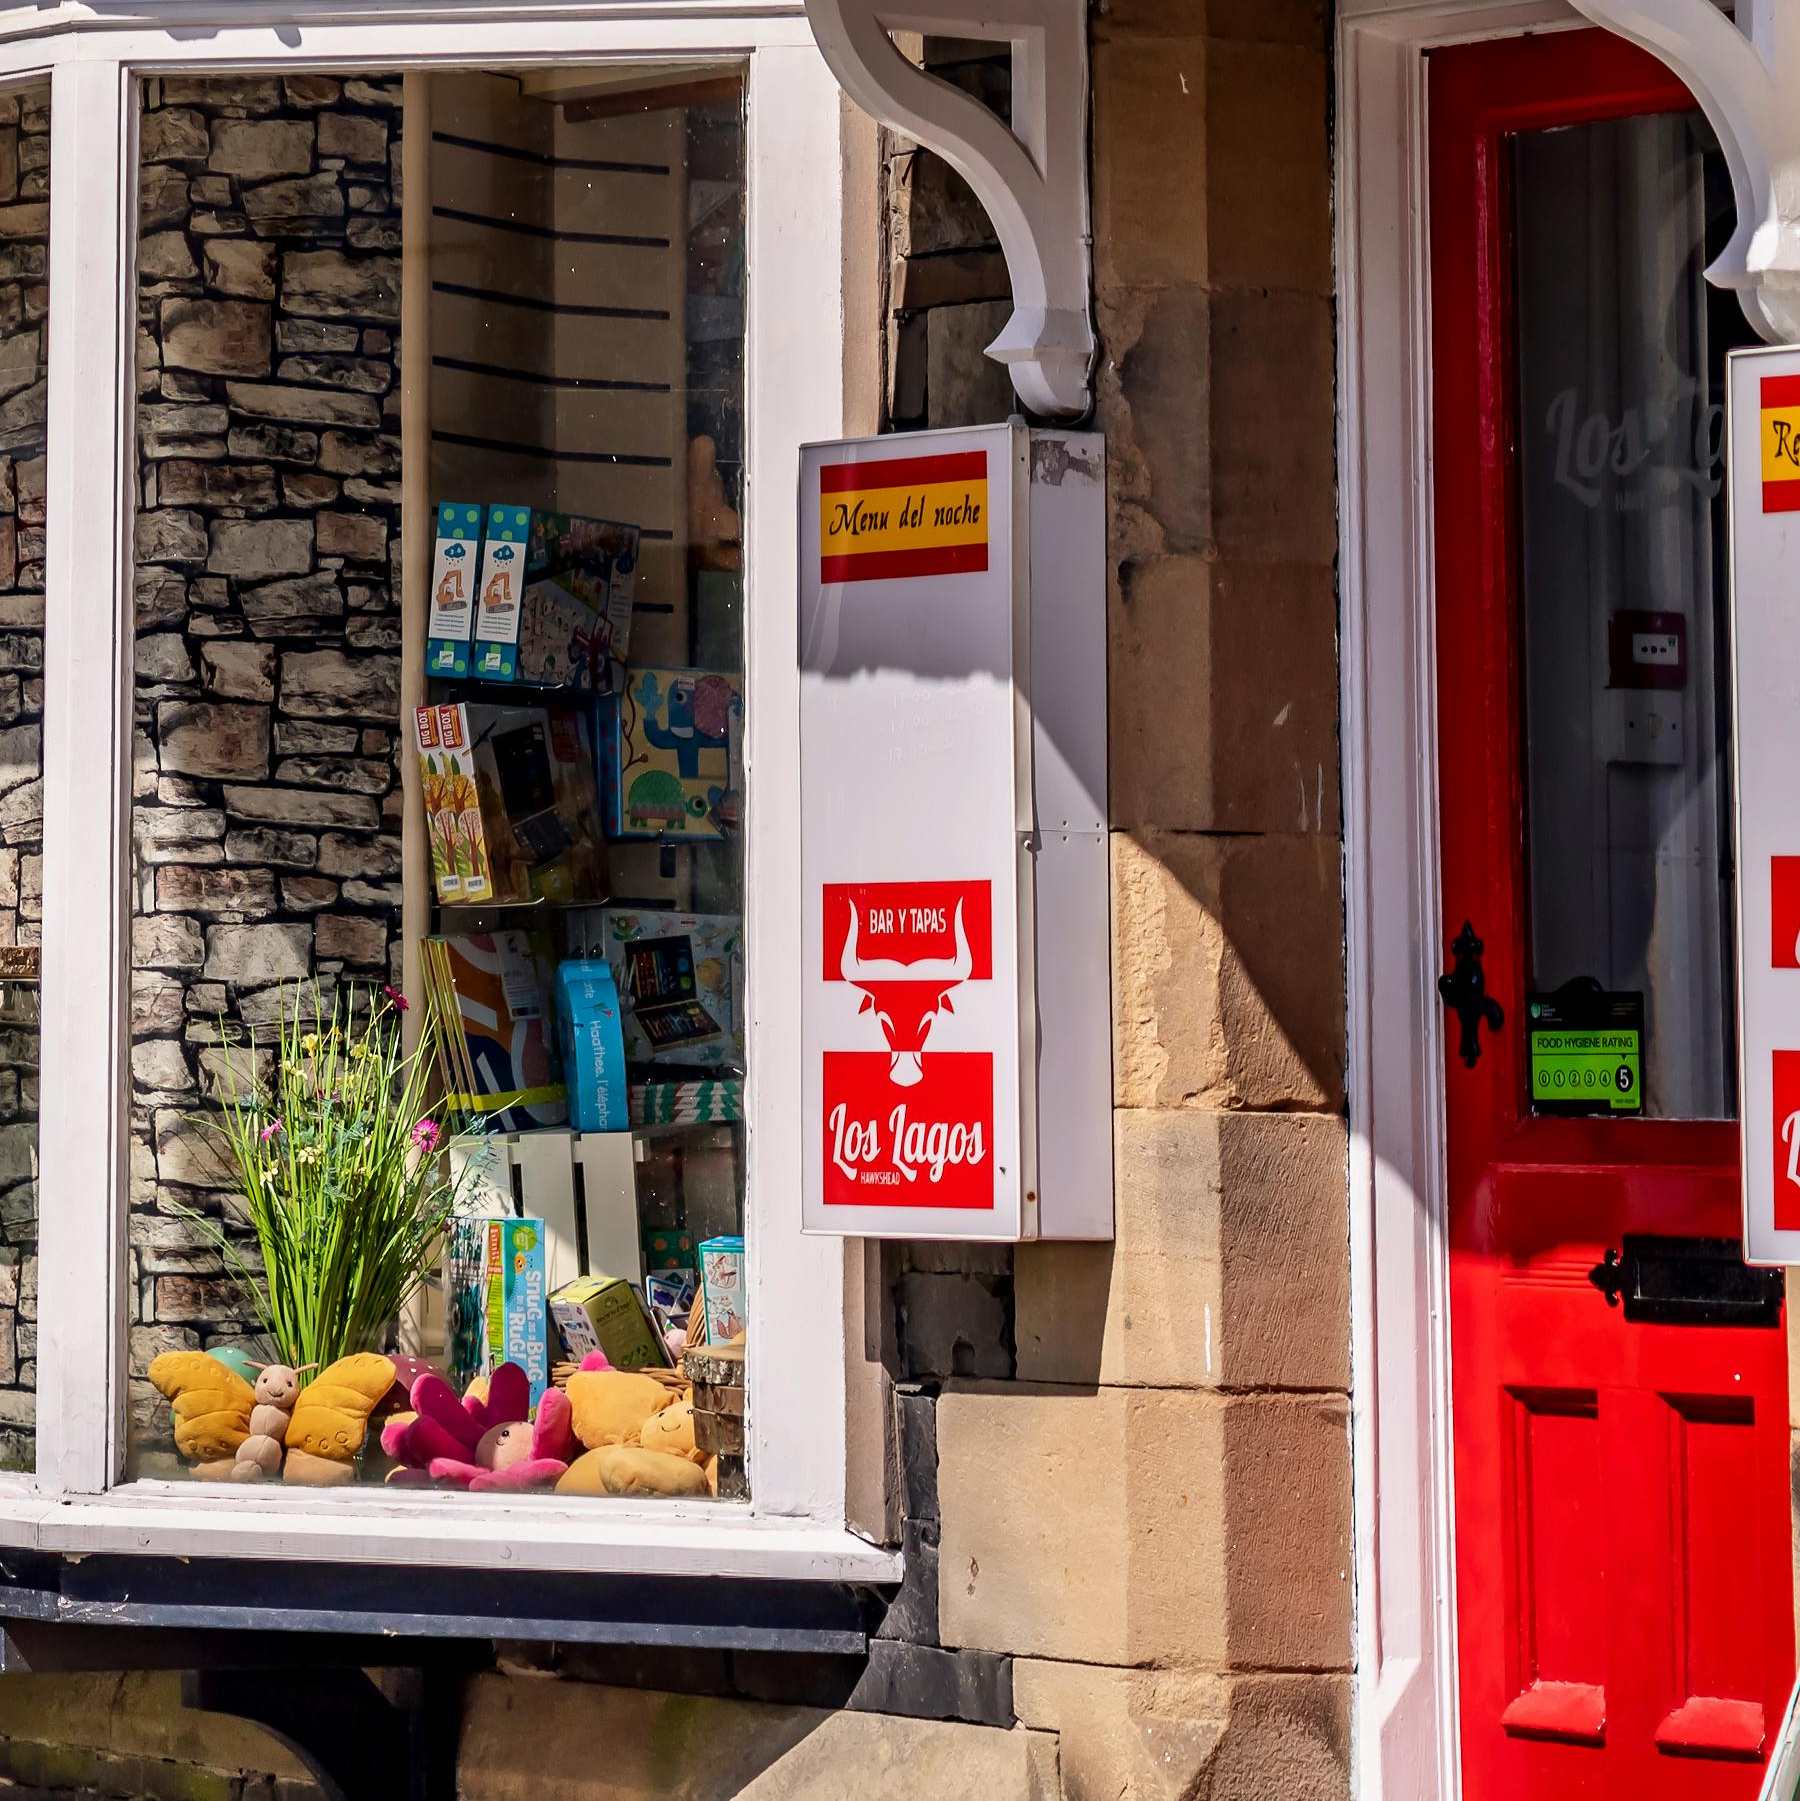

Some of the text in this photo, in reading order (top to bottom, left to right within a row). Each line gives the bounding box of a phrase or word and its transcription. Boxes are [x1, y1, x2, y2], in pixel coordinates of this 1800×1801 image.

[828, 493, 981, 536] Menu del noche
[417, 711, 432, 745] BIG BOX
[440, 711, 455, 745] BIG BOX
[869, 907, 947, 935] BAR Y TAPAS
[1537, 1036, 1634, 1049] FOOD HYGIENE RATING
[1619, 1068, 1630, 1089] 5
[828, 1102, 986, 1183] Los Lagos
[860, 1171, 900, 1185] HAWKSHEAD
